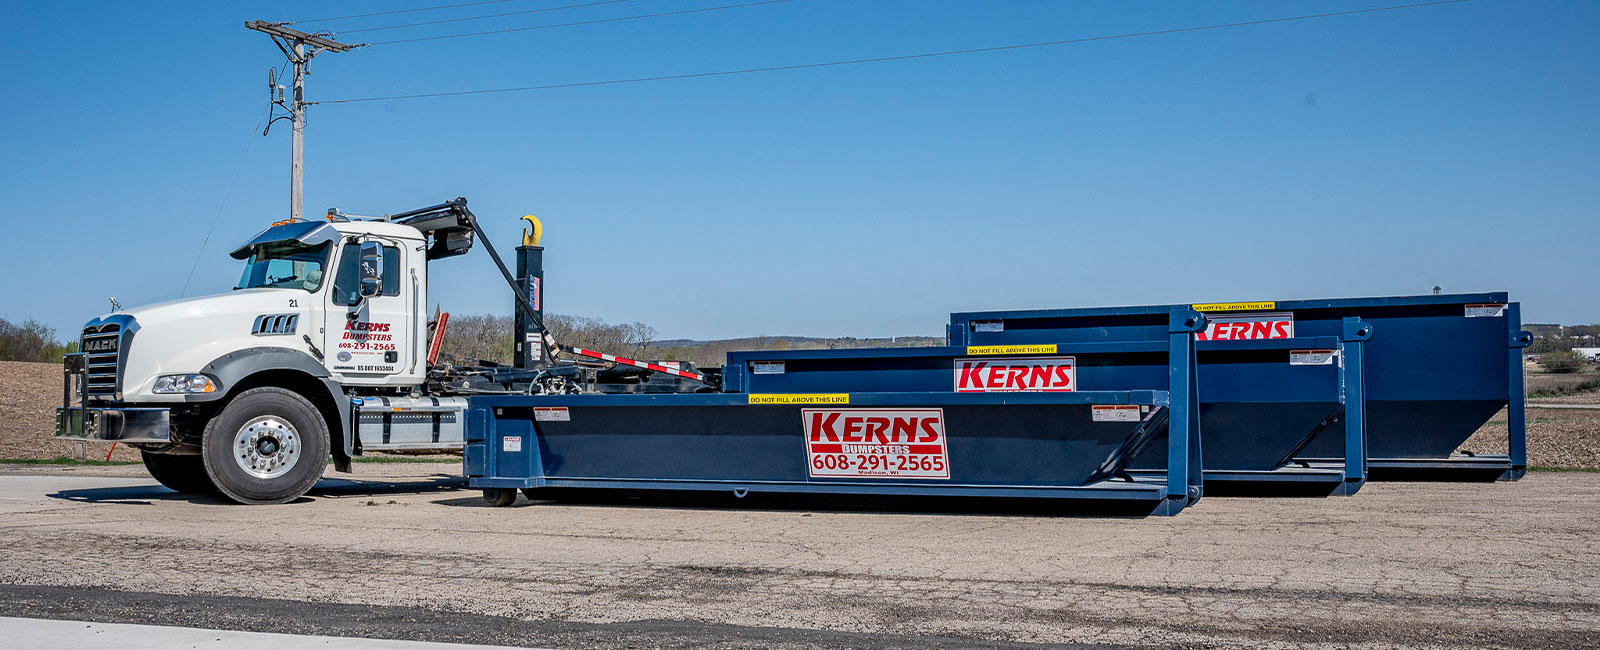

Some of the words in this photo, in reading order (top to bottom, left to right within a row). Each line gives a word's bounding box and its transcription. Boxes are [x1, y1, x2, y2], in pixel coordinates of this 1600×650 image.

[289, 299, 298, 307] 21
[345, 320, 391, 332] KERNS
[343, 331, 392, 341] DUMPSTERS
[85, 338, 117, 351] MACK
[338, 342, 395, 350] 608-291-2565
[959, 361, 1072, 390] KERNS
[810, 412, 940, 445] KERNS
[841, 444, 911, 454] DUMPSTERS
[813, 454, 944, 471] 608-291-2565
